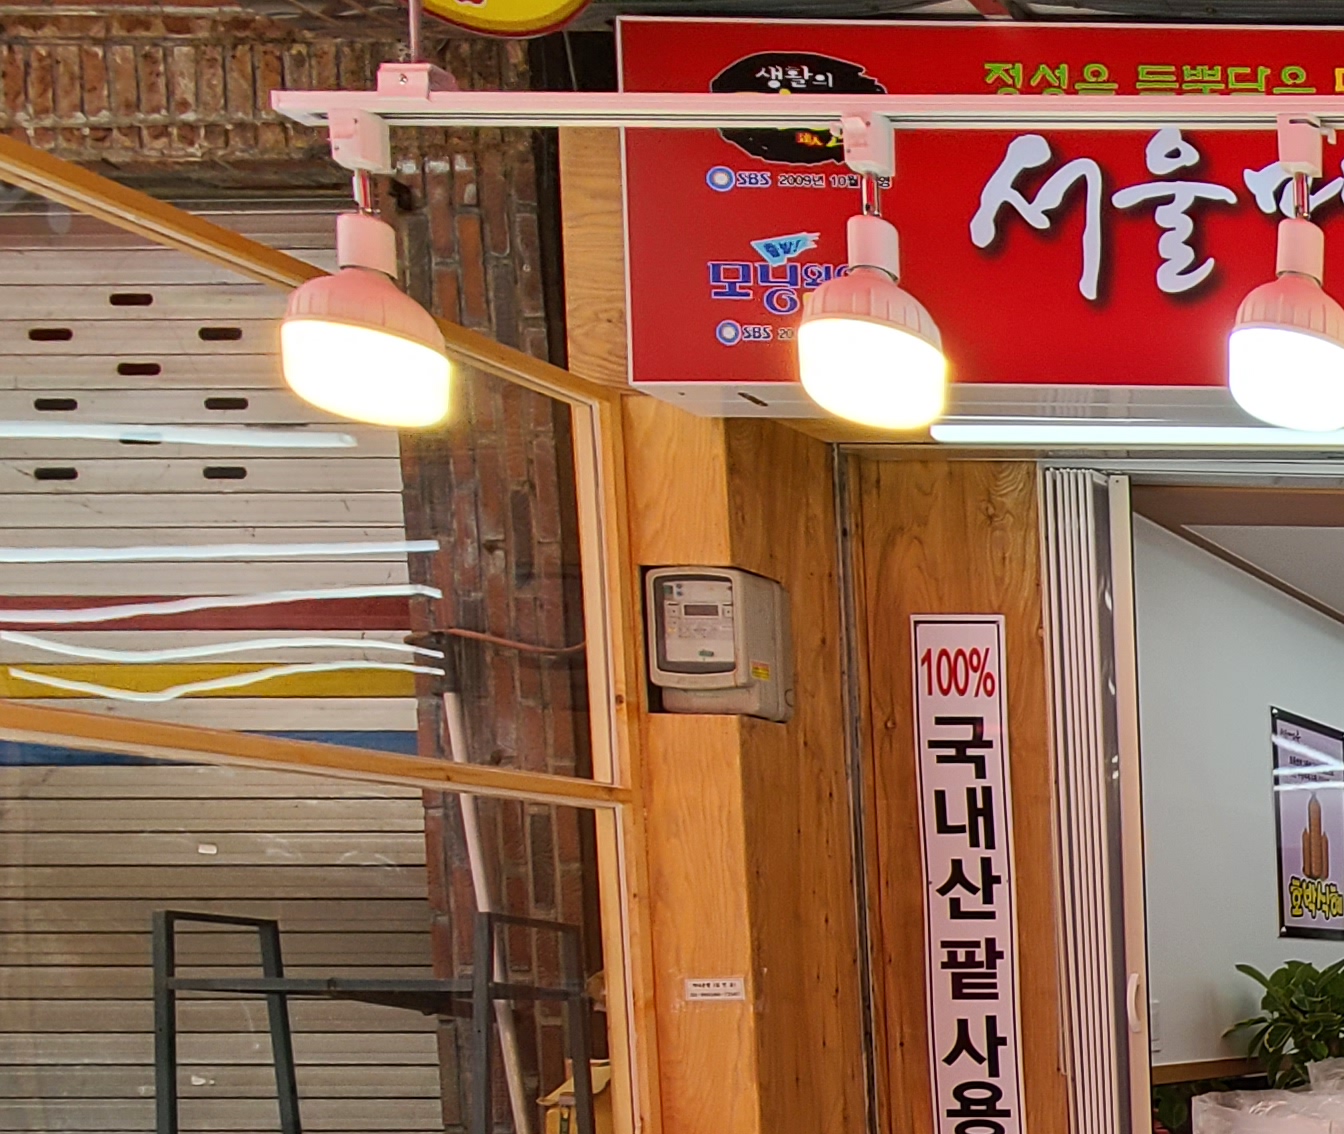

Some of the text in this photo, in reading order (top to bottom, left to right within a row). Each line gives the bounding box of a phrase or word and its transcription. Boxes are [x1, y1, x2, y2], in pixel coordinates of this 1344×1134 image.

[755, 65, 834, 89] 생활의
[736, 172, 771, 187] SBS
[778, 174, 826, 187] 2009년
[708, 260, 850, 315] 모닝와
[741, 326, 772, 340] SBS
[920, 645, 996, 698] 100%
